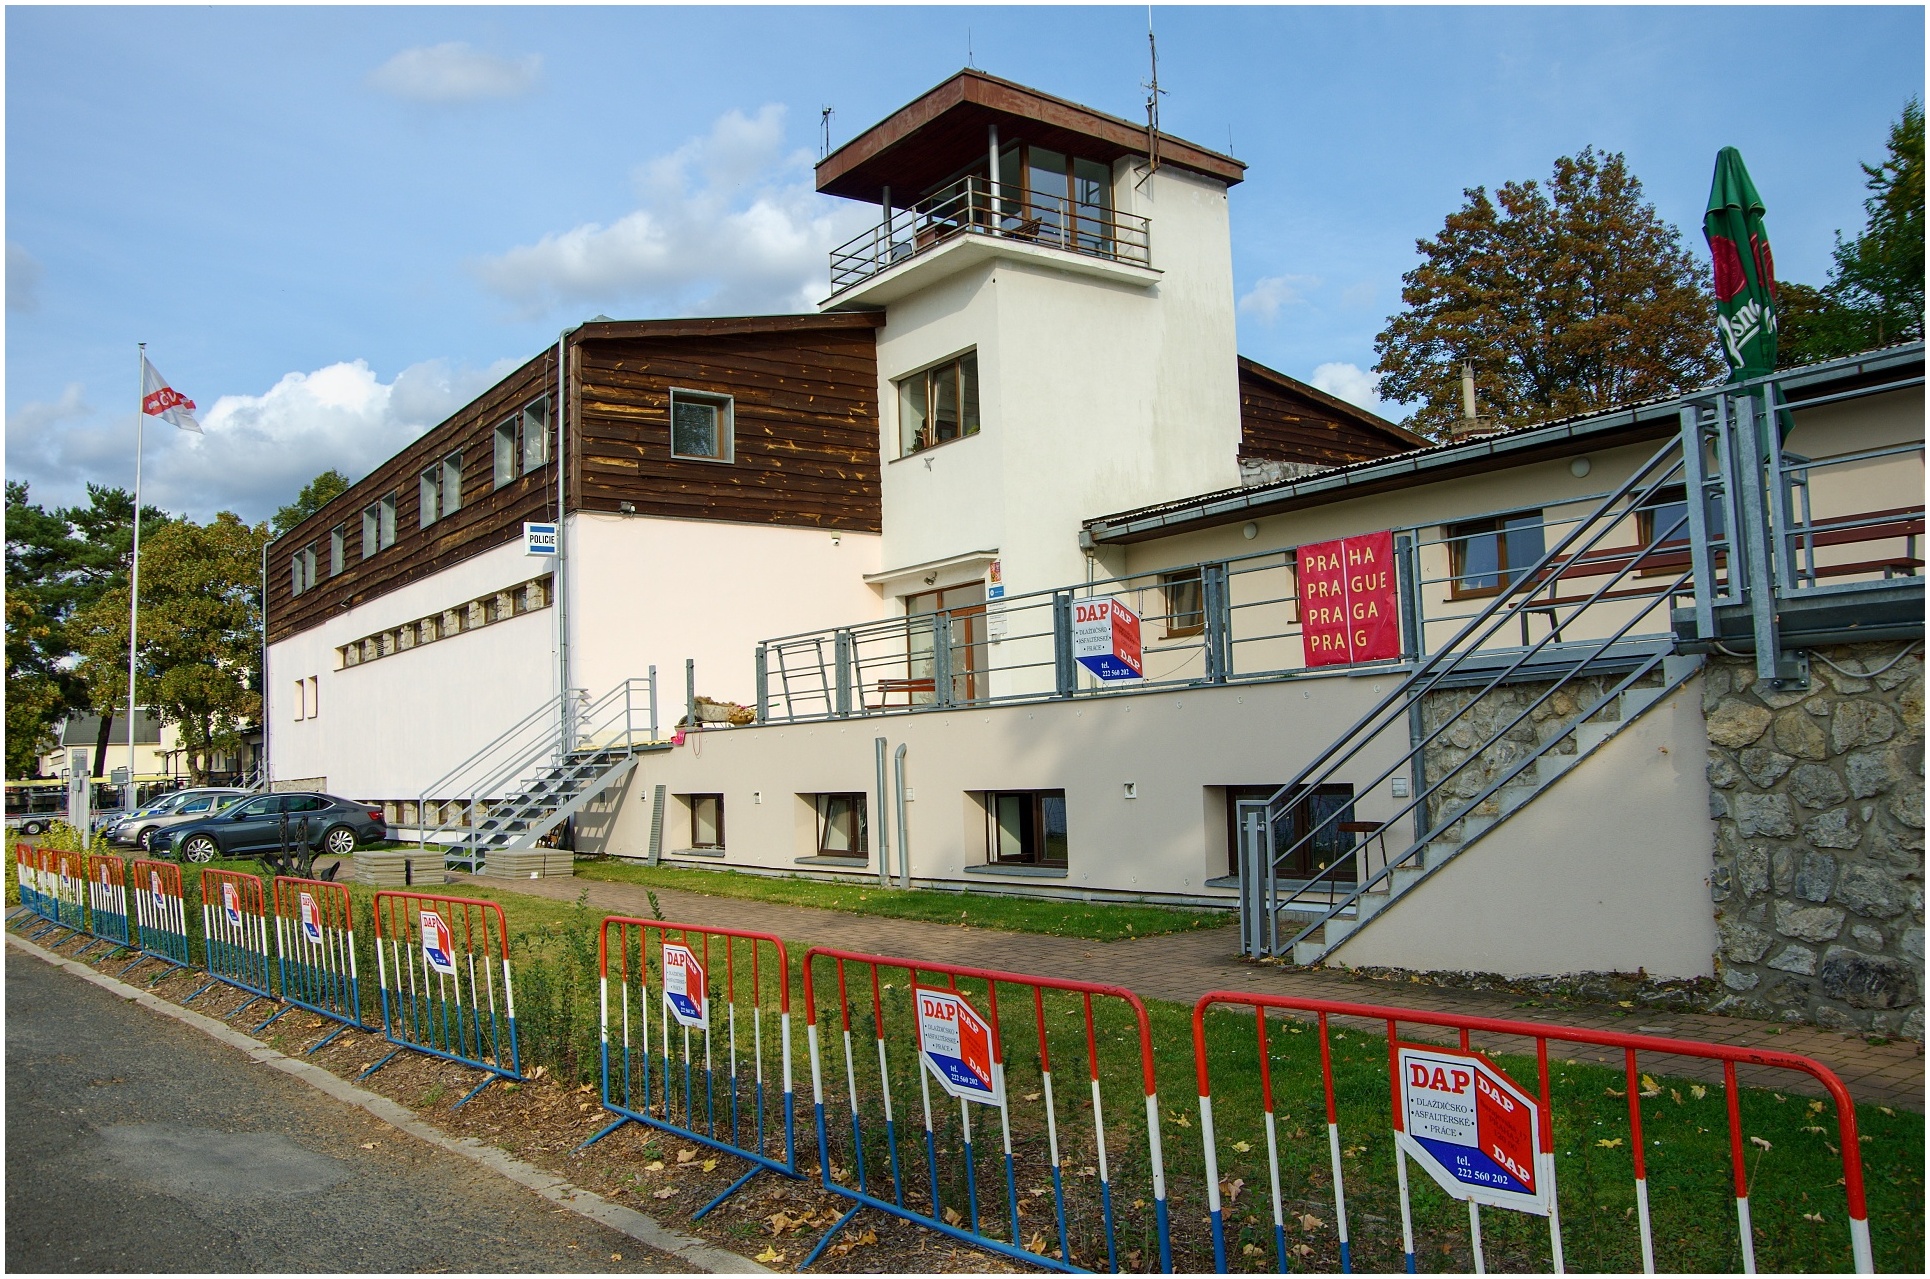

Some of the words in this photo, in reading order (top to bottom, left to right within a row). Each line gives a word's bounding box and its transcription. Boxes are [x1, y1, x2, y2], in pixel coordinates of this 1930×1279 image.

[530, 534, 555, 544] POLICIE
[1306, 553, 1340, 573] PRA
[1349, 546, 1375, 566] HA
[1308, 580, 1342, 600] PRA
[1351, 571, 1386, 592] GUE
[1076, 603, 1109, 622] DAP
[1113, 604, 1132, 624] DAP
[1309, 606, 1343, 626] PRA
[1353, 601, 1378, 620] GA
[1311, 632, 1345, 652] PRA
[1354, 630, 1367, 647] G
[1120, 649, 1140, 670] DAP
[667, 952, 685, 966] DAP
[924, 1000, 955, 1021] DAP
[958, 1008, 979, 1034] DAP
[969, 1057, 990, 1083] DAP
[1410, 1063, 1470, 1094] DAP
[1477, 1075, 1514, 1113] DAP
[1416, 1098, 1467, 1113] DLAŽDIČSKO
[1414, 1110, 1470, 1126] ASFALTÉRSKÉ
[1430, 1124, 1457, 1136] PRÁCE
[1456, 1156, 1470, 1166] tel.
[1492, 1144, 1530, 1182] DAP
[1457, 1167, 1472, 1178] 222
[1474, 1170, 1490, 1181] 560
[1492, 1174, 1508, 1185] 202
